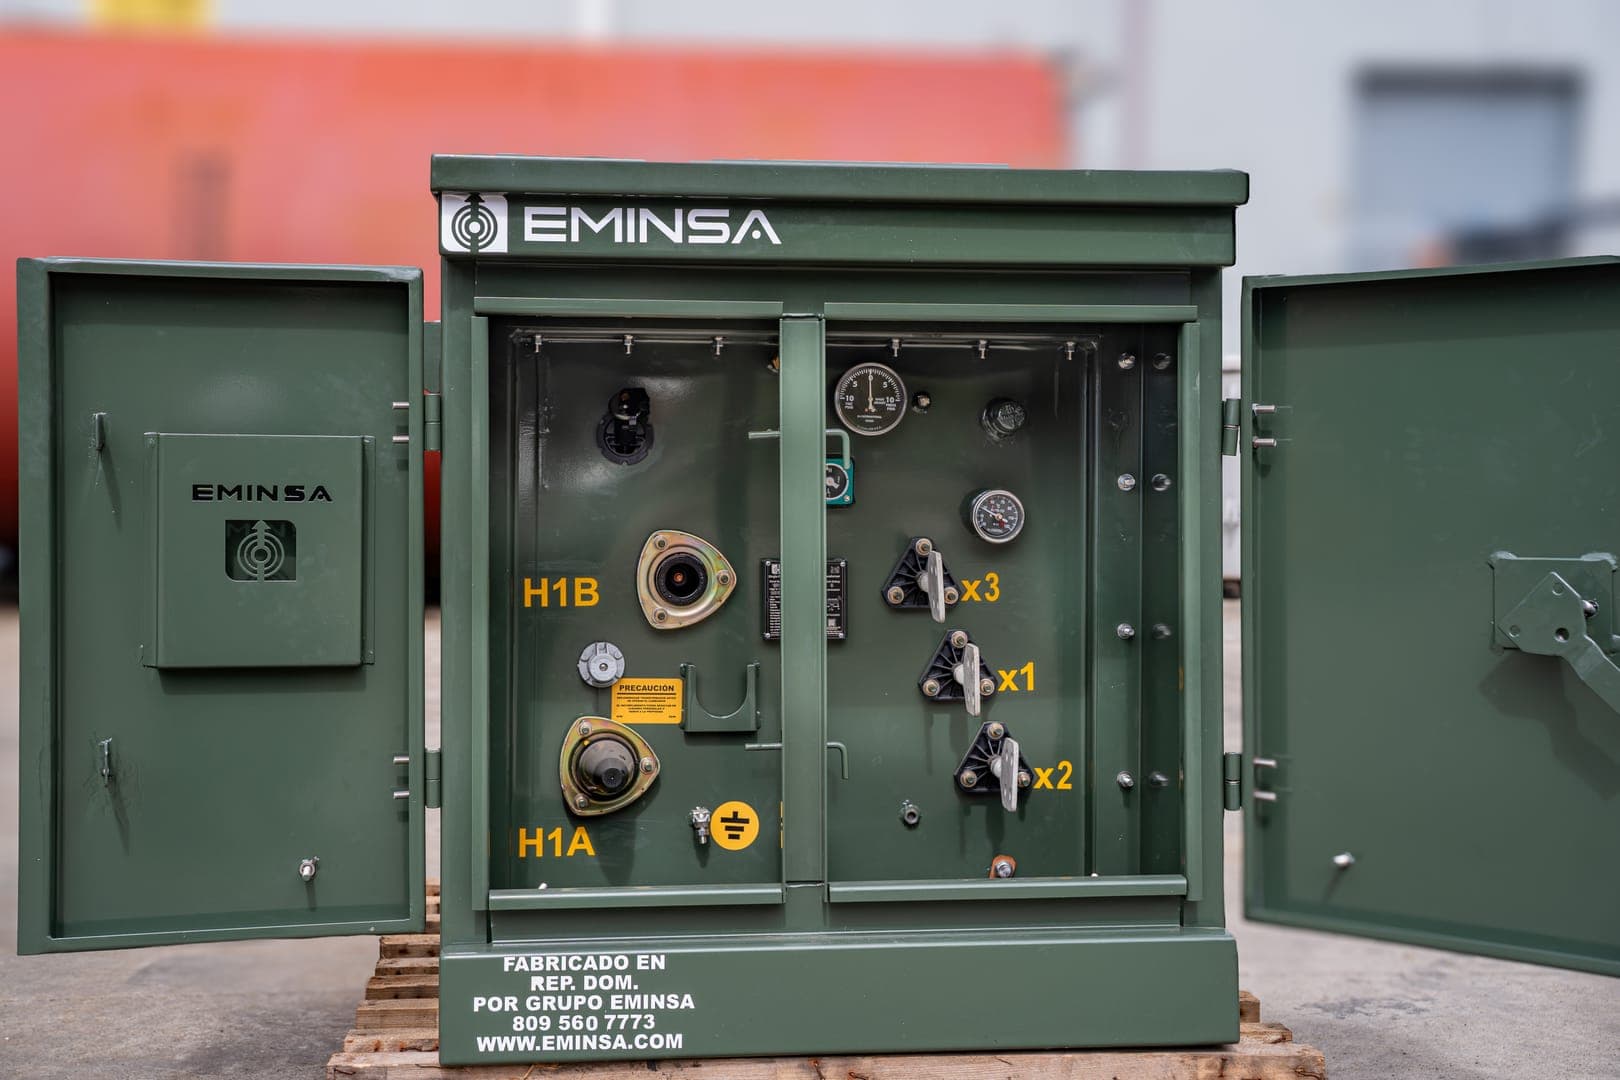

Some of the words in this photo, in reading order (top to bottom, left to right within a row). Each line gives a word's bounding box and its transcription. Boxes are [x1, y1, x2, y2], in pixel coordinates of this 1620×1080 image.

[524, 206, 782, 244] EMINSA
[192, 484, 333, 502] EMINSA
[524, 577, 600, 607] H1B
[518, 826, 596, 858] H1A
[503, 955, 629, 972] FABRICADO
[637, 955, 666, 970] EN
[530, 976, 575, 991] REP.
[584, 975, 639, 991] DOM.
[473, 997, 518, 1012] POR
[525, 995, 603, 1011] GRUPO
[610, 994, 695, 1010] EMINSA
[512, 1016, 551, 1031] 809
[558, 1015, 598, 1031] 560
[604, 1014, 656, 1031] 7773
[476, 1034, 683, 1052] WWW.EMINSA.COM
